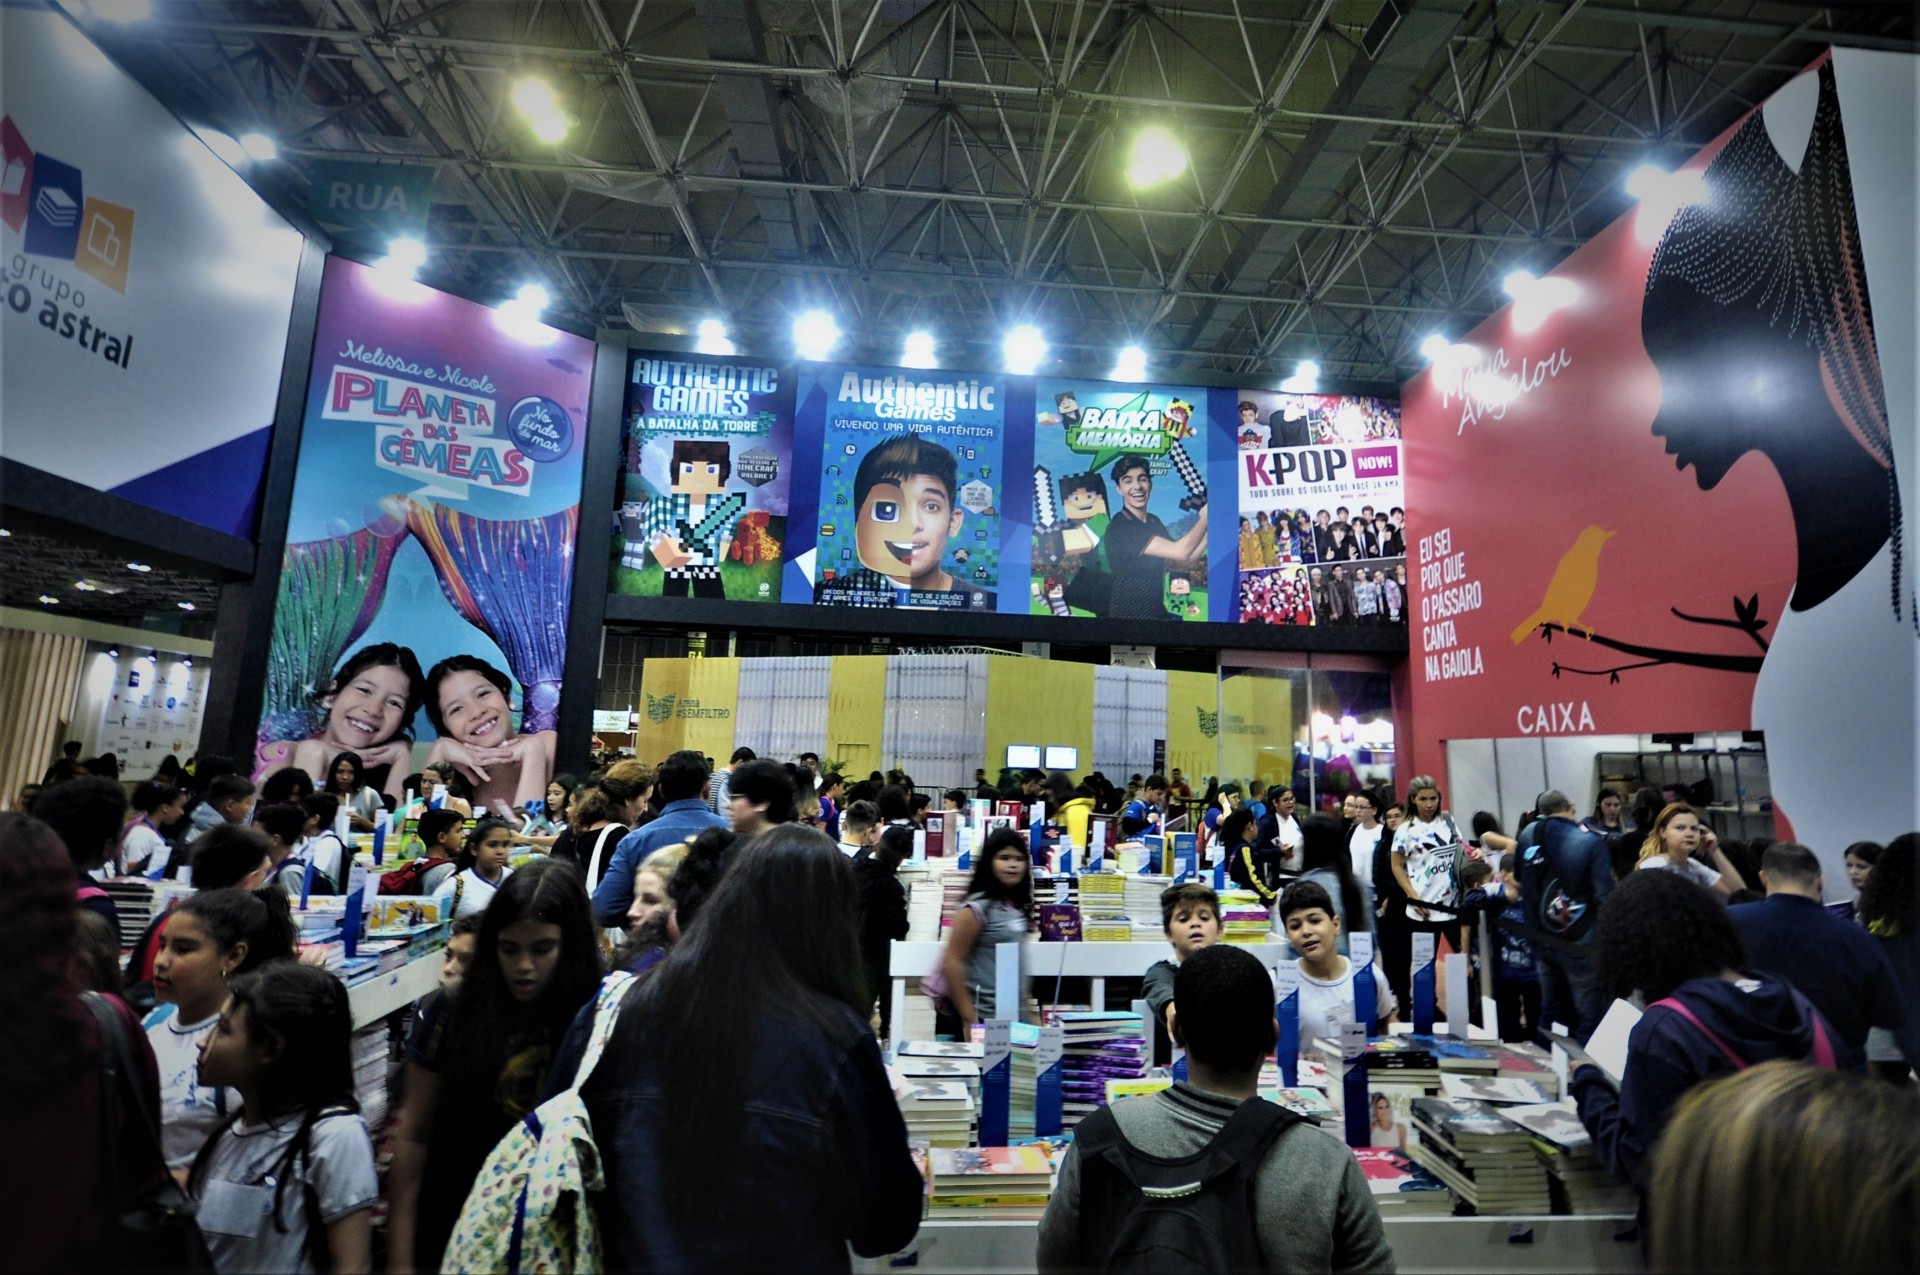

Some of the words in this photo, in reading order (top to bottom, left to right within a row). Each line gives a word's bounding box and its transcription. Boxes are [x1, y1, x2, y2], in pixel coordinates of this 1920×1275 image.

[328, 182, 409, 212] RUA
[12, 253, 86, 308] grupo
[38, 300, 133, 369] astral
[339, 340, 422, 376] Melissa
[423, 367, 437, 379] e
[438, 365, 496, 394] Nicole
[632, 358, 778, 393] AUTHENTIC
[332, 372, 492, 427] PLANETA
[652, 386, 750, 417] GAMES
[838, 372, 995, 411] Authentic
[529, 405, 552, 423] No
[636, 418, 645, 429] A
[648, 418, 697, 431] BATALHA
[703, 420, 719, 431] DA
[722, 421, 758, 432] TORRE
[874, 399, 957, 422] Games
[1080, 408, 1160, 431] BAIXA
[423, 422, 459, 441] DAS
[518, 414, 560, 439] fundo
[835, 419, 879, 431] VIVENDO
[883, 422, 904, 432] UMA
[908, 424, 933, 433] VIDA
[937, 424, 993, 437] AUTÊNTICA
[1076, 428, 1161, 449] MEMÓRIA
[380, 428, 530, 487] GÊMEAS
[531, 435, 561, 453] mar
[1357, 455, 1394, 471] NOW!
[1249, 489, 1269, 499] TODO
[1271, 487, 1294, 497] SOBRE
[1298, 486, 1307, 494] OS
[1310, 484, 1331, 493] IDOLS
[1420, 538, 1433, 564] EU
[1434, 528, 1451, 558] SEI
[1420, 561, 1442, 592] POR
[1443, 552, 1466, 584] QUE
[1422, 597, 1430, 622] O
[1432, 580, 1482, 620] PÁSSARO
[1423, 620, 1457, 652] CANTA
[1425, 654, 1441, 682] NA
[1442, 646, 1484, 679] GAIOLA
[676, 708, 730, 719] #SEMFILTRO
[1517, 701, 1596, 734] CAIXA
